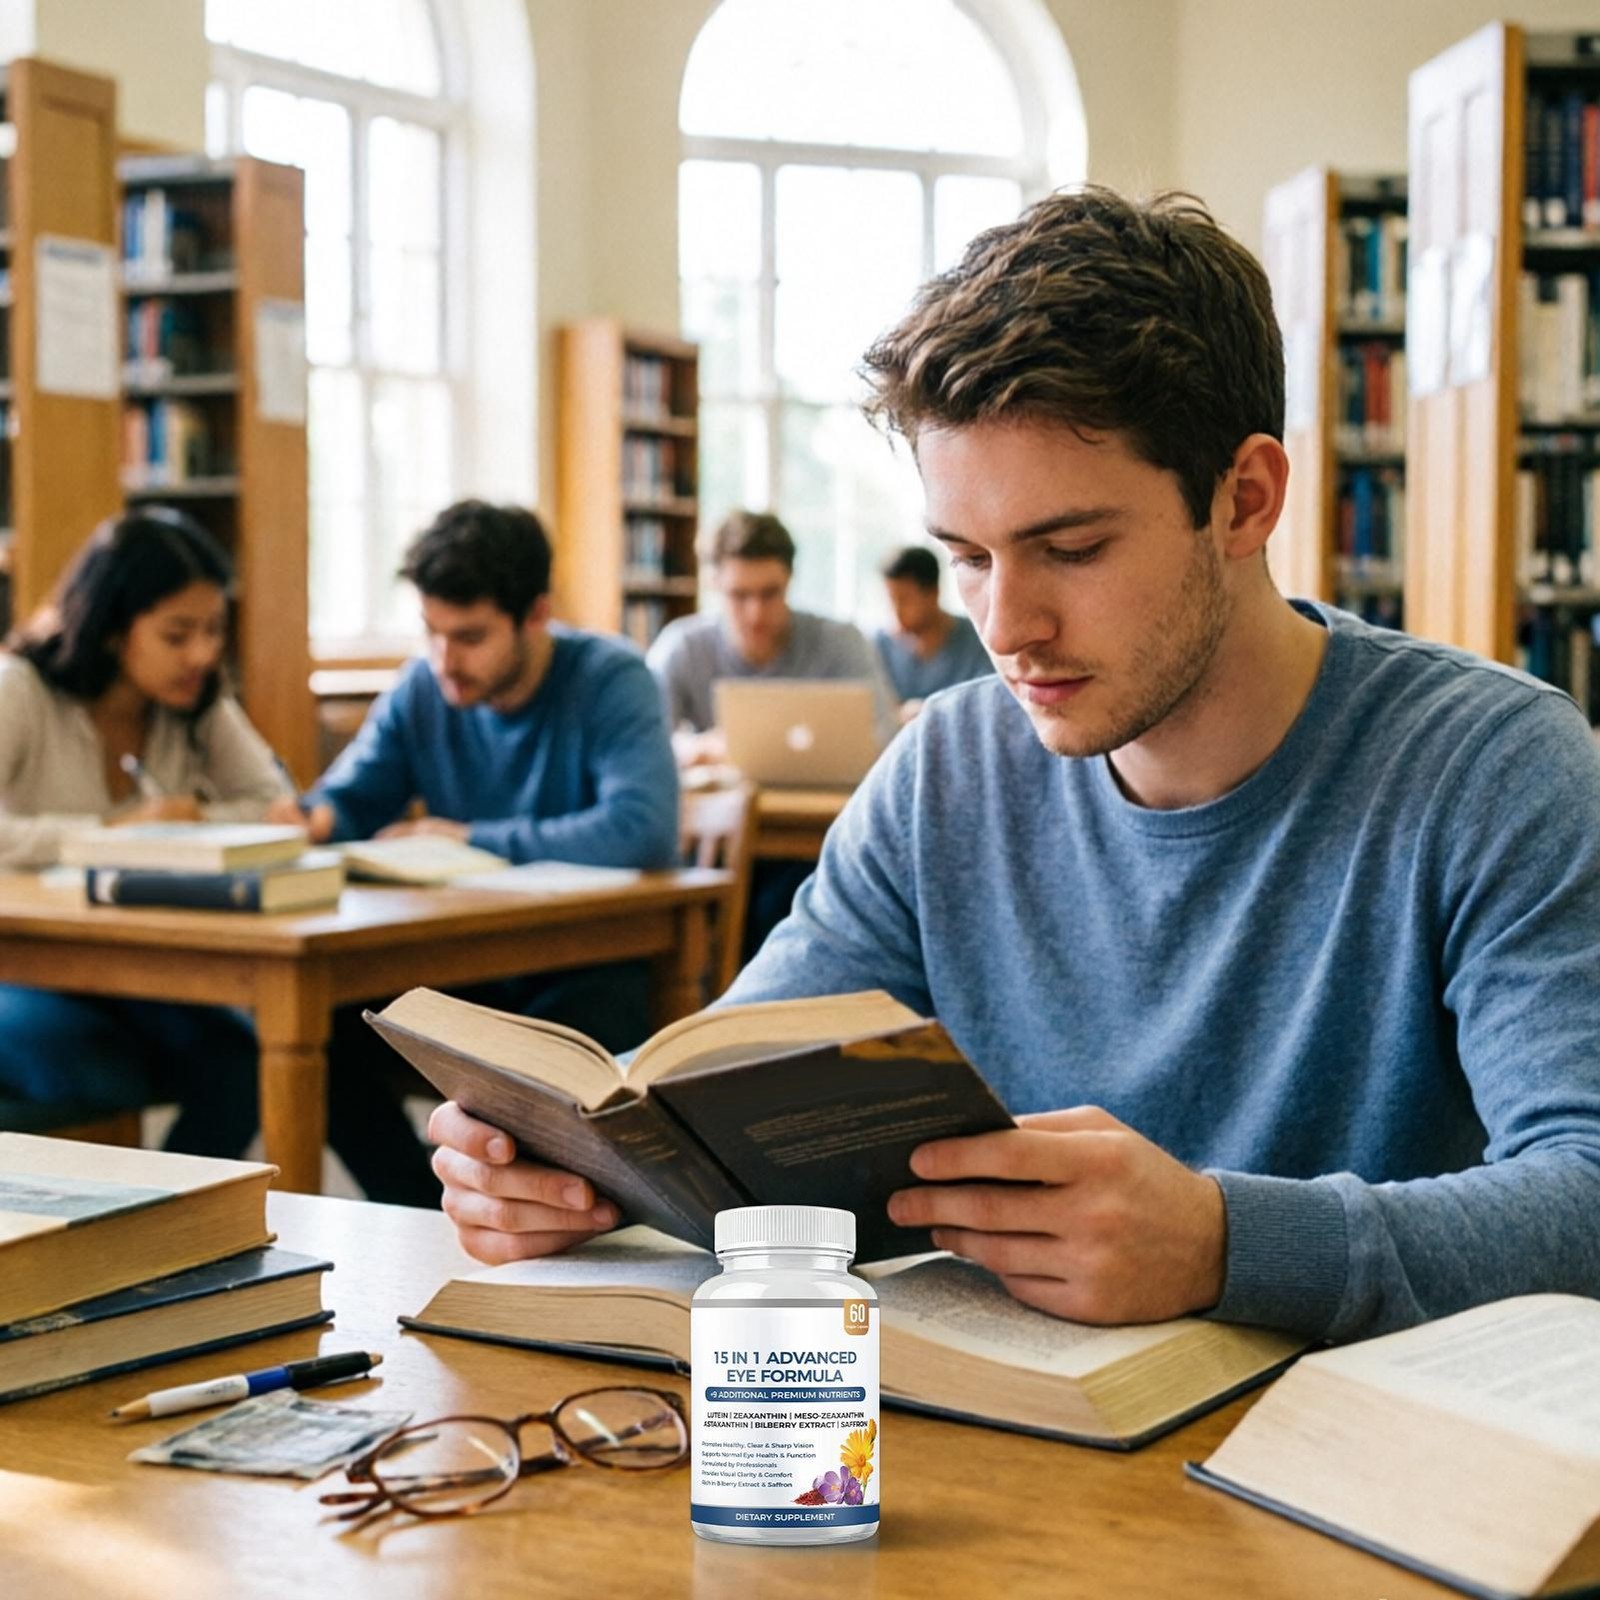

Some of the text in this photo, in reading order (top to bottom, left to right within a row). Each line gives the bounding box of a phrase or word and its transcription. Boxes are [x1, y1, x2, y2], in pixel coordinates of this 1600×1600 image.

[850, 1304, 865, 1322] 60
[714, 1351, 857, 1364] 15 IN 1 ADVANCED
[727, 1370, 844, 1382] EYE FORMULA
[718, 1391, 769, 1399] ADDITIONAL
[771, 1391, 817, 1399] PREMIUM
[735, 1513, 836, 1521] DIETARY SUPPLEMENT
